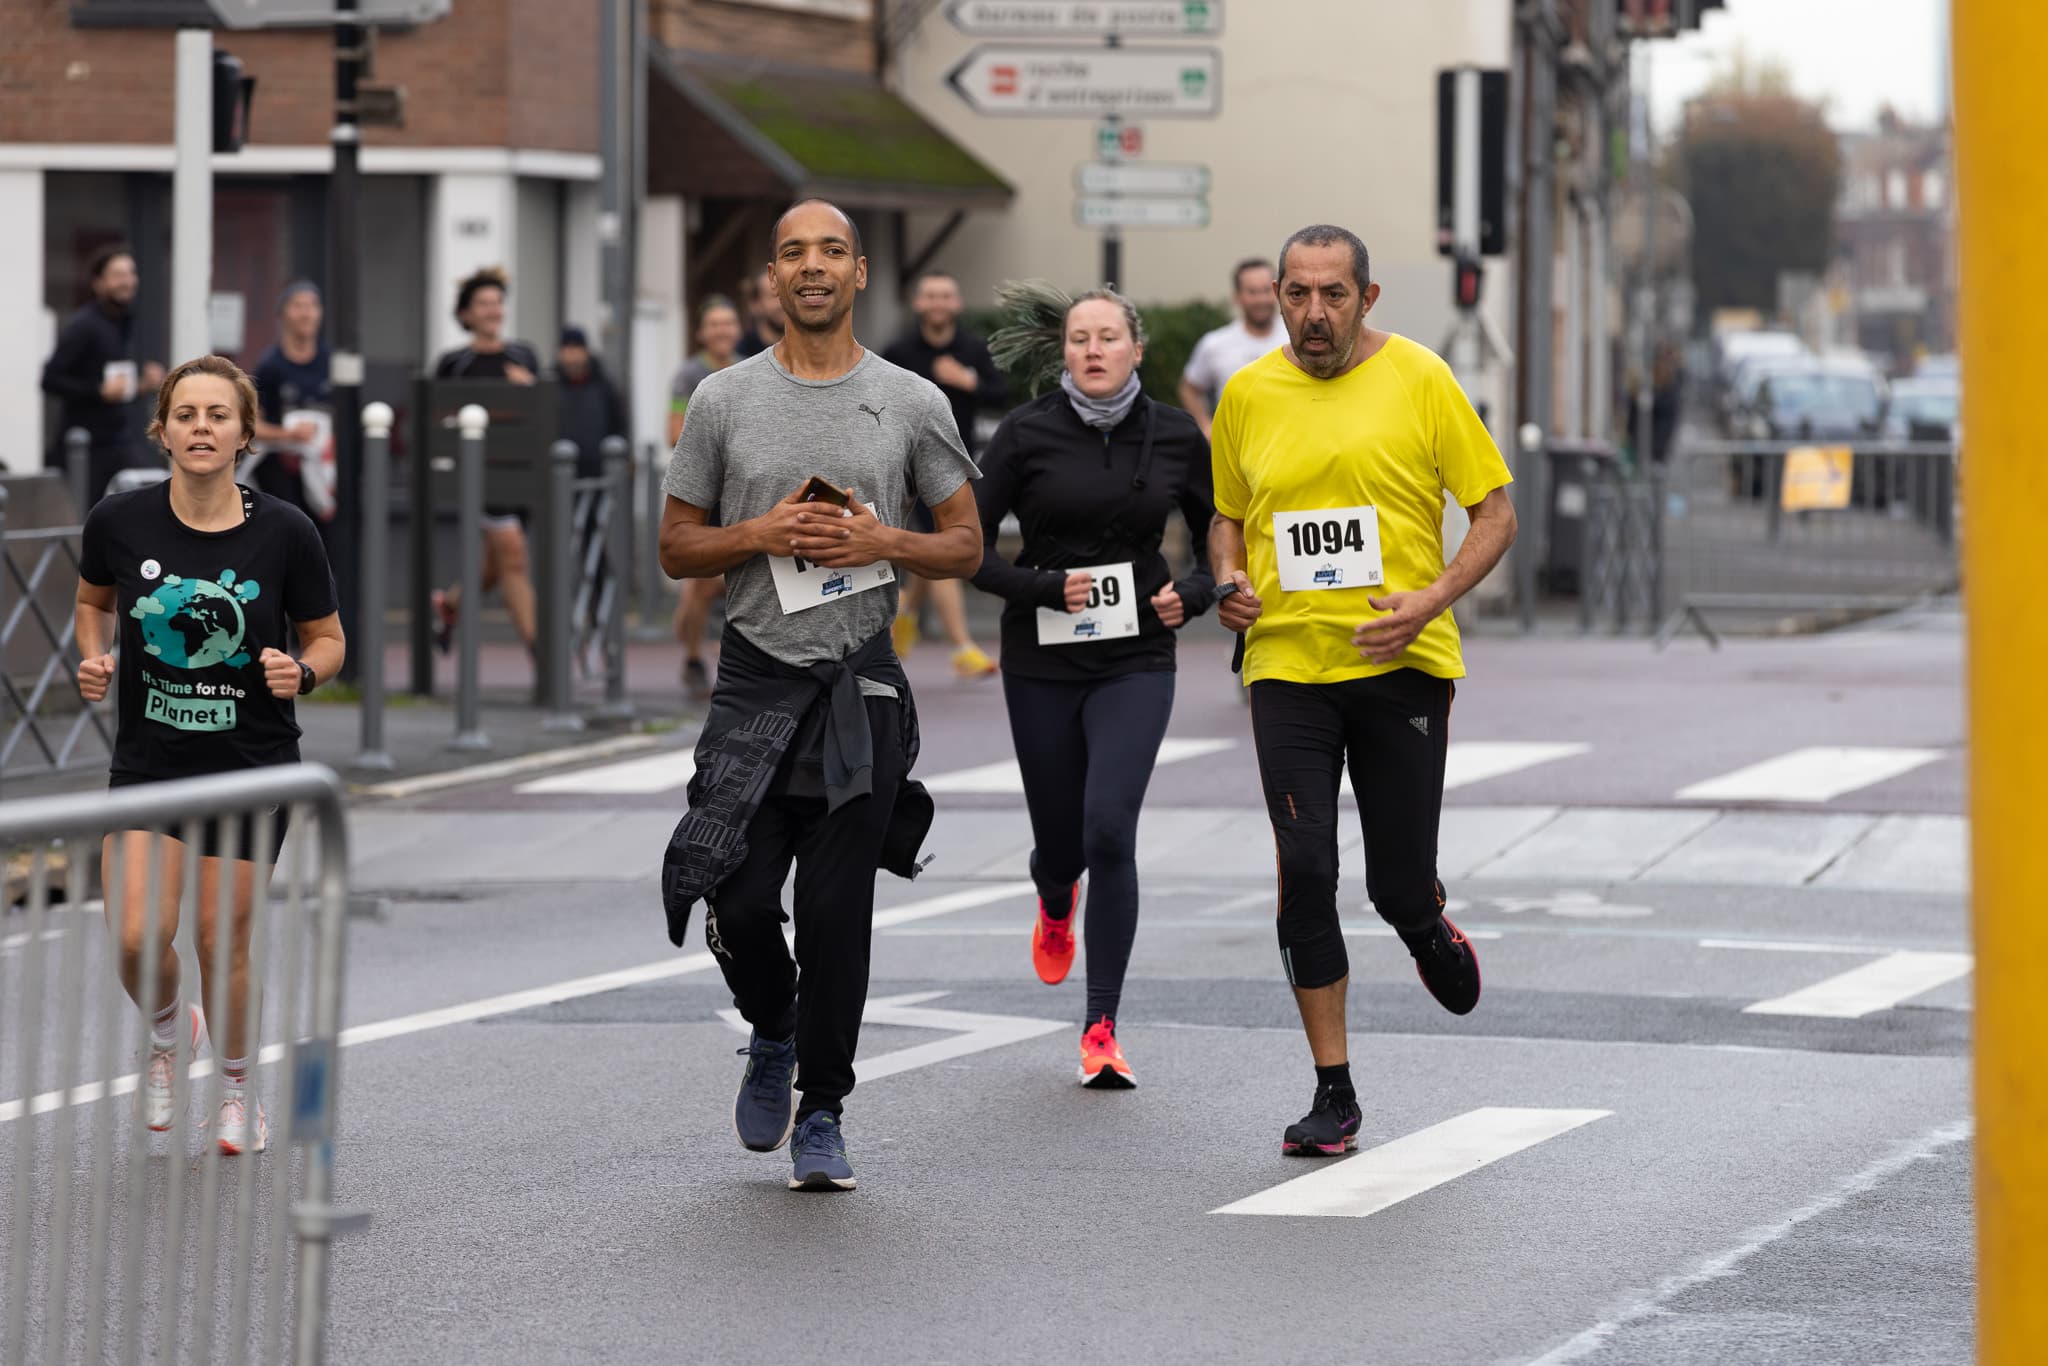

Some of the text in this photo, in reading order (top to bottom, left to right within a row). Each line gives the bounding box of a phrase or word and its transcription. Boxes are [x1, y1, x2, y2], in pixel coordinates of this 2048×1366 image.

[1287, 519, 1364, 557] 1094
[158, 678, 193, 695] Time
[195, 682, 217, 696] for
[220, 684, 246, 698] the
[151, 695, 232, 725] Planet !
